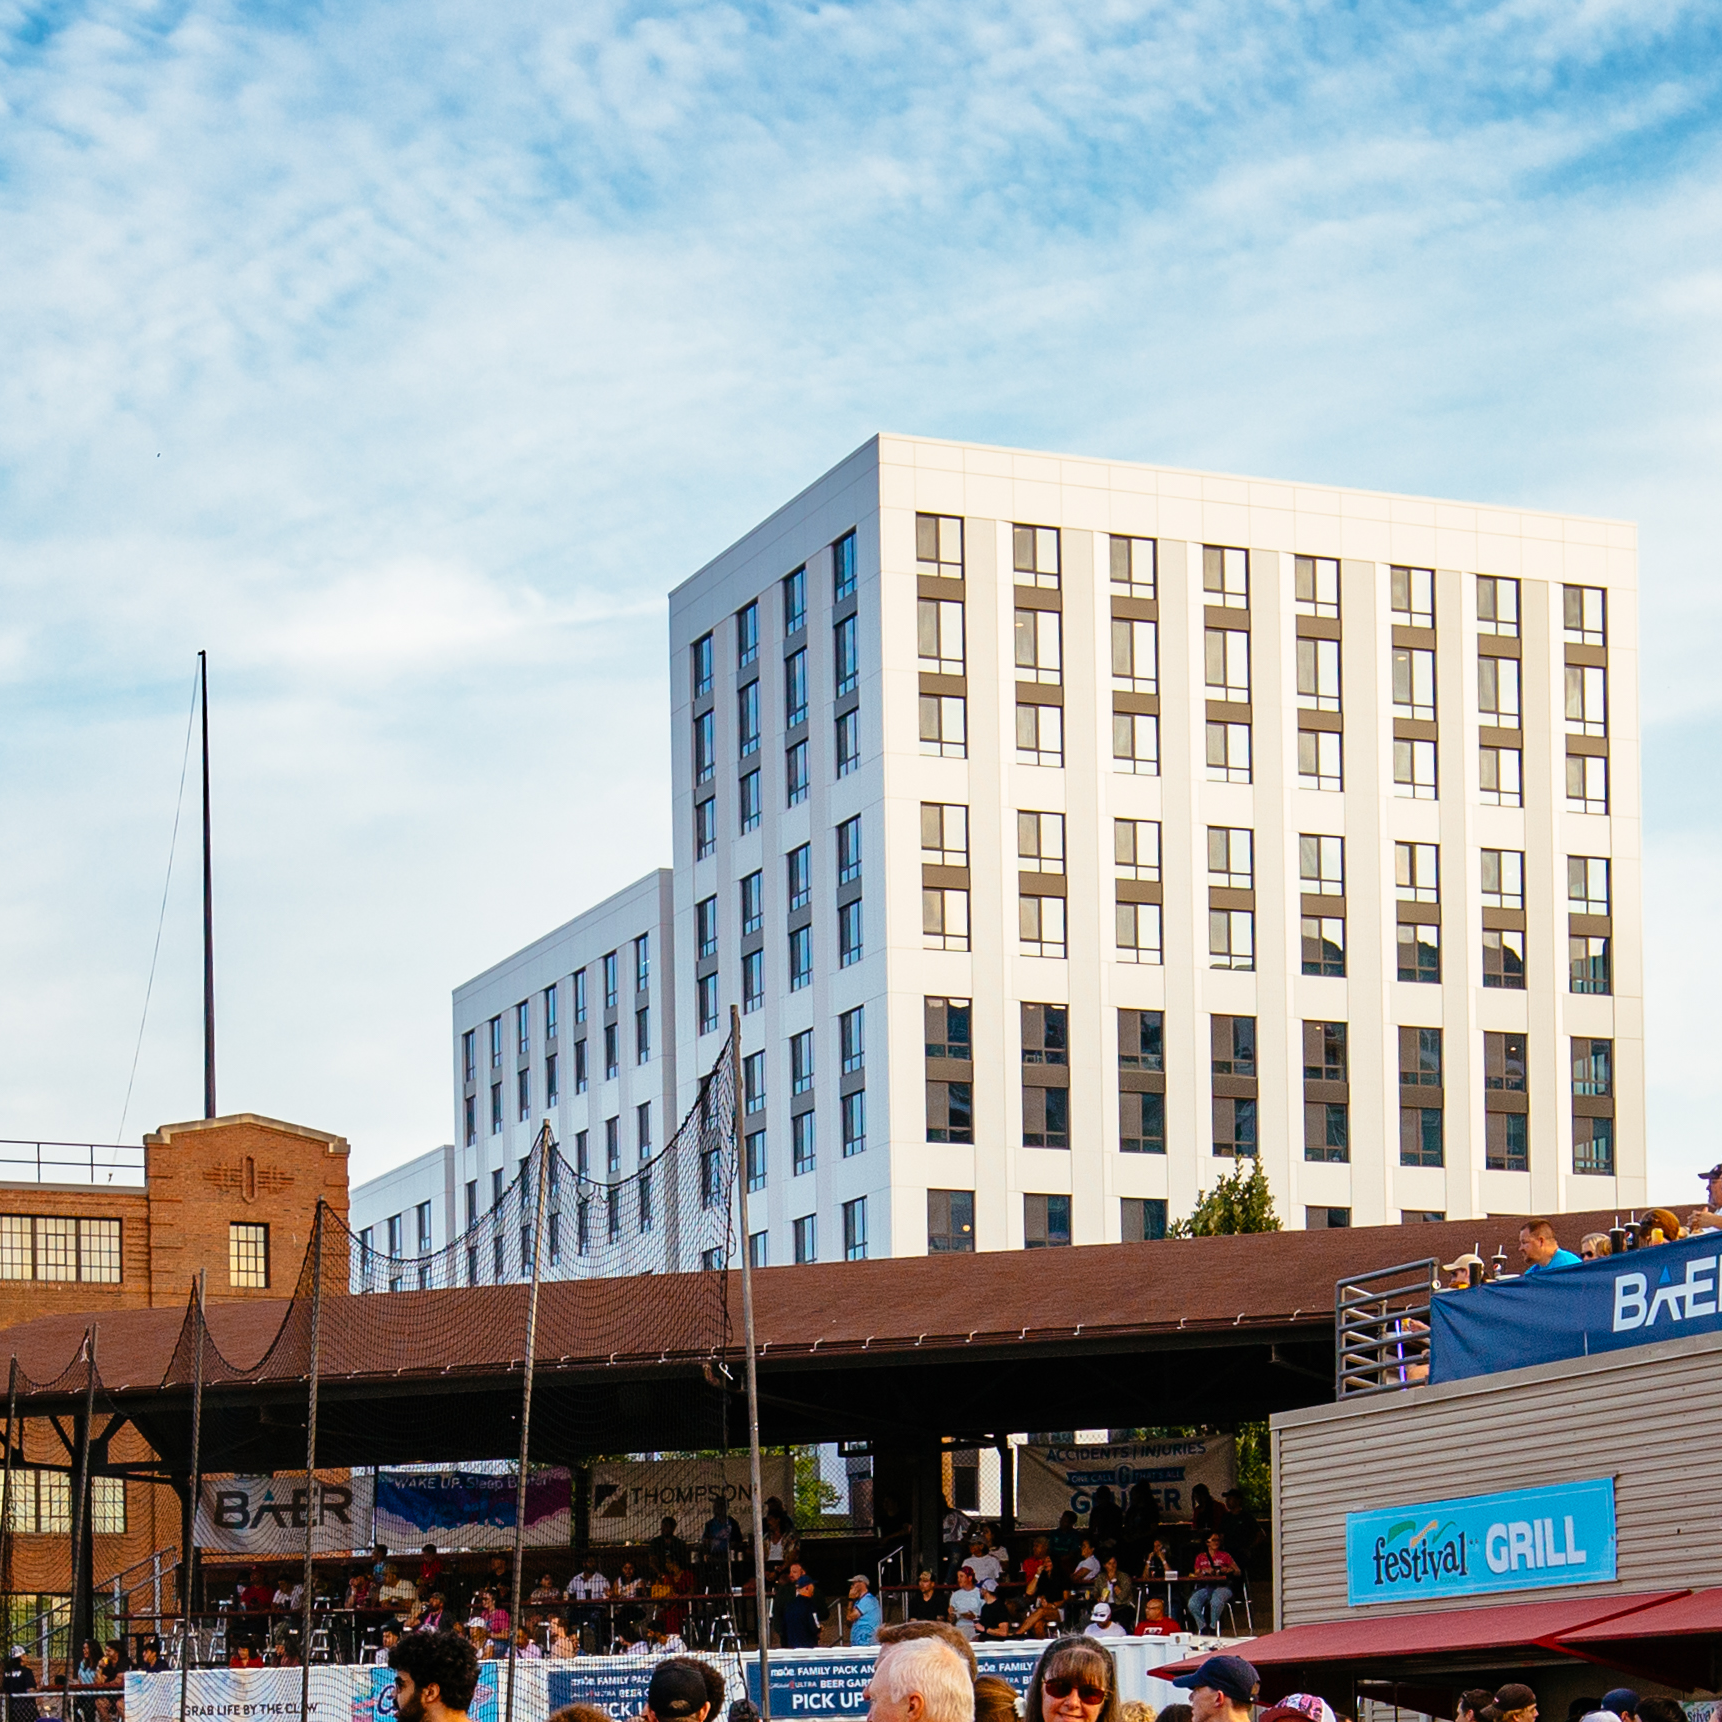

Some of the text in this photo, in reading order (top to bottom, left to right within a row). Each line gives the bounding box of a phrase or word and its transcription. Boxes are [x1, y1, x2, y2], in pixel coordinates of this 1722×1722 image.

[1046, 1441, 1207, 1462] ACCIDENTS INJURIES
[394, 1475, 437, 1492] WAKE
[630, 1483, 753, 1506] THOMPSON
[215, 1486, 354, 1530] BAER
[1373, 1515, 1587, 1585] festival GRILL
[797, 1666, 831, 1676] FAMILY
[832, 1665, 858, 1675] PACK
[860, 1664, 876, 1674] AN
[999, 1661, 1033, 1672] FAMILY
[597, 1675, 630, 1685] FAMILY
[820, 1679, 845, 1689] BEER
[619, 1688, 643, 1698] BEER
[792, 1691, 865, 1709] PICK UP
[184, 1704, 214, 1717] GRAB
[217, 1703, 241, 1716] LIFE
[243, 1703, 257, 1716] BY
[258, 1702, 282, 1715] THE
